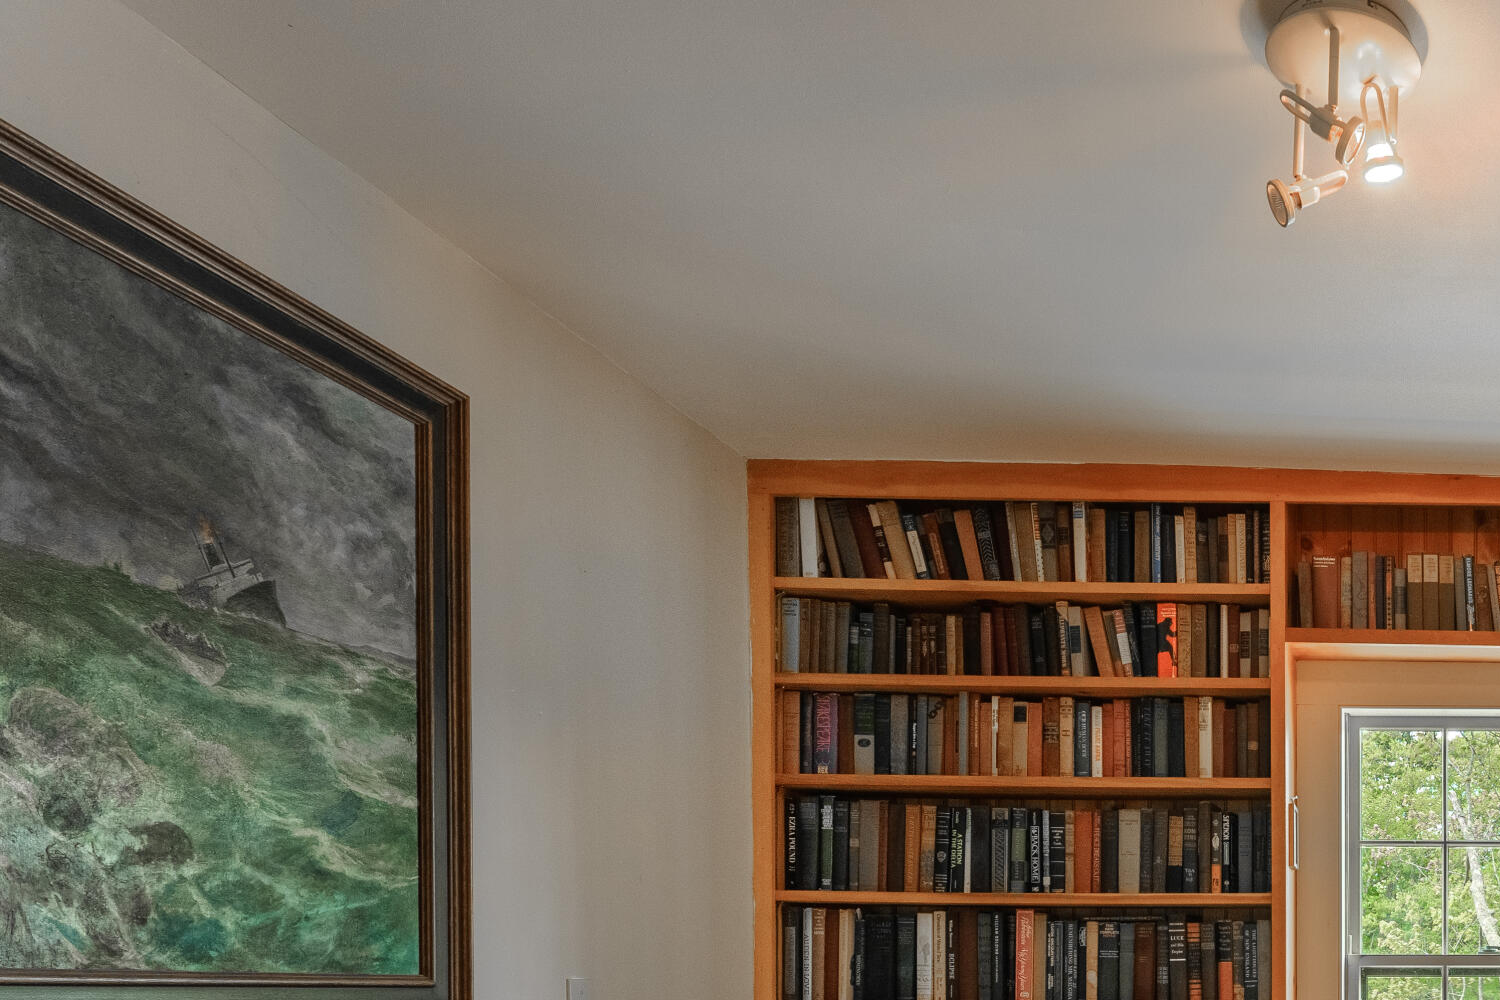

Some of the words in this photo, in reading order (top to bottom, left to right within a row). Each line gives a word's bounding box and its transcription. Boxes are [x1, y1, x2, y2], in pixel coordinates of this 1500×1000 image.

[815, 695, 831, 753] SHAKESPEARE
[788, 816, 796, 836] EZRA
[1222, 814, 1230, 840] SIMENON
[788, 838, 796, 863] POUND
[1031, 838, 1040, 855] BACK
[1031, 857, 1040, 881] HOME
